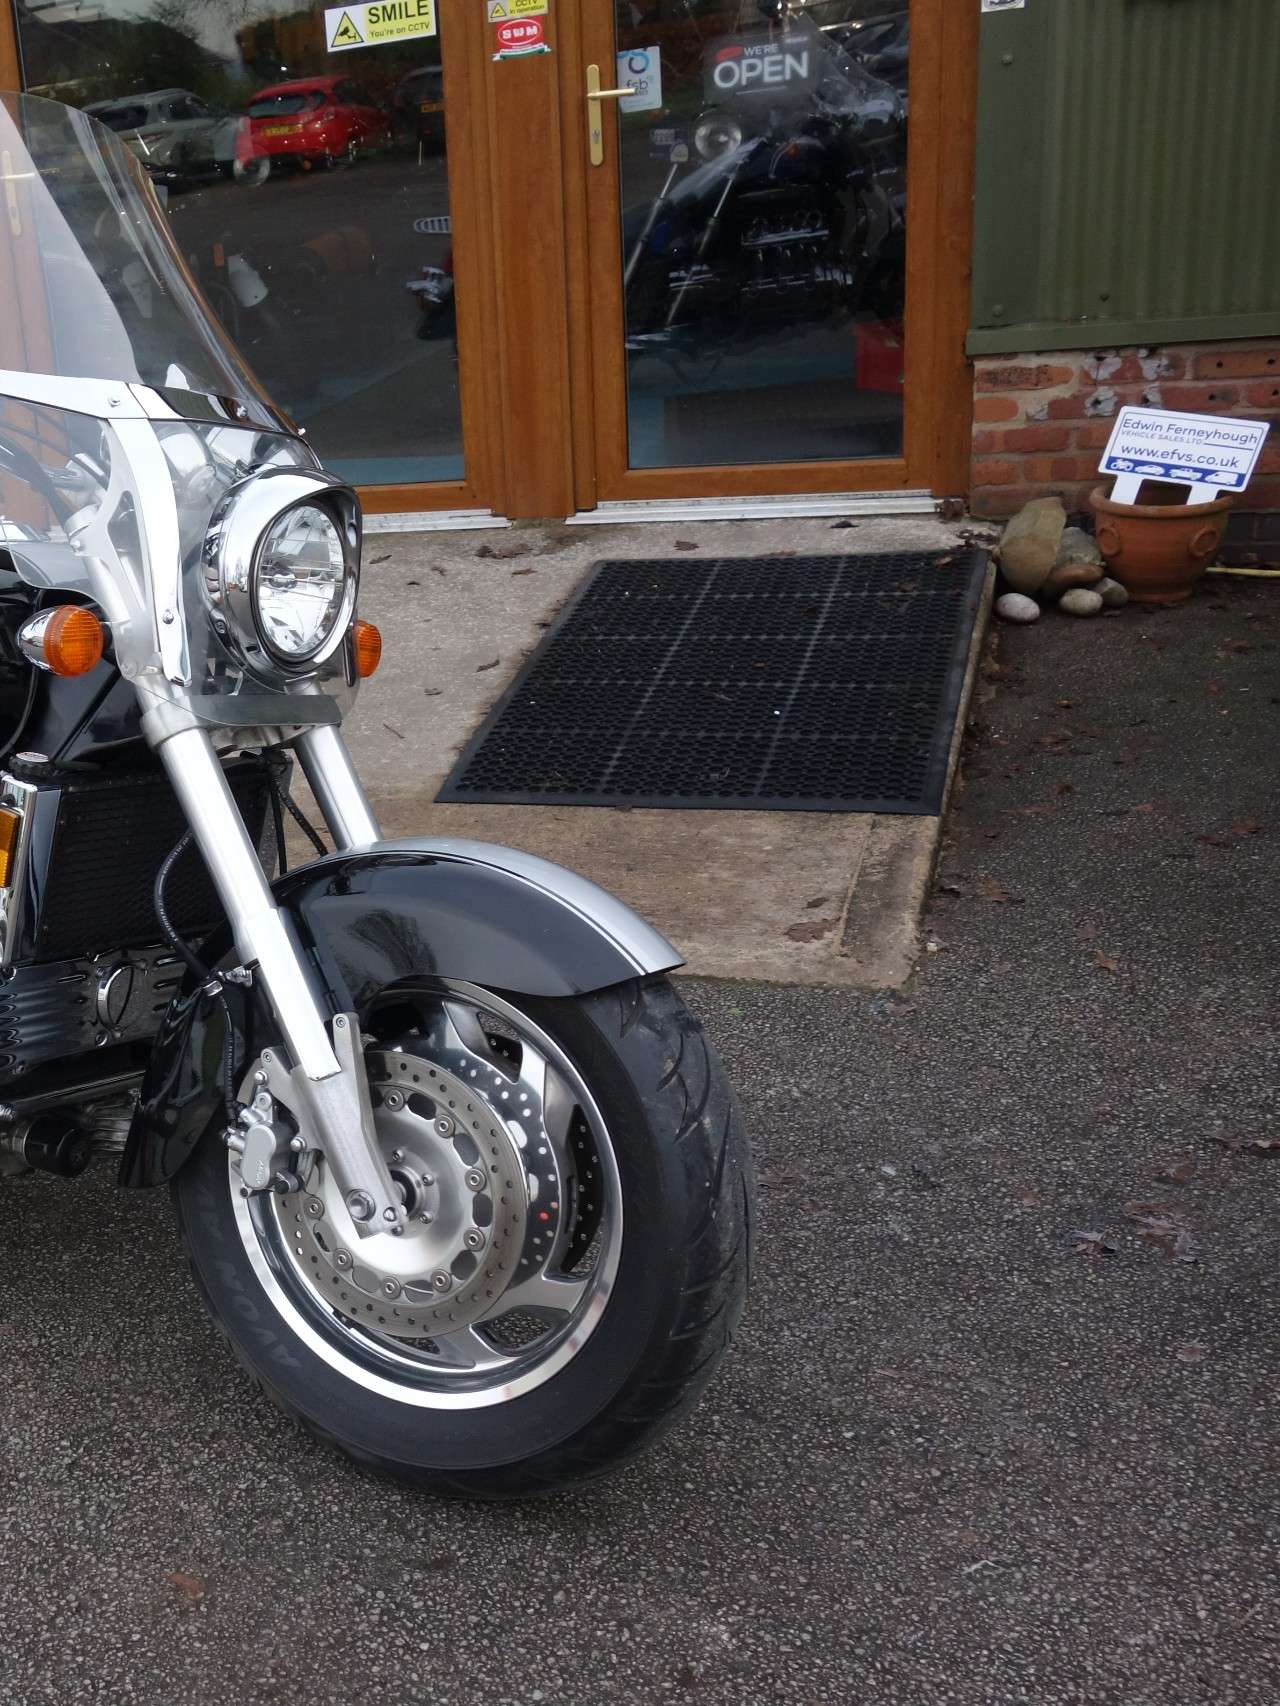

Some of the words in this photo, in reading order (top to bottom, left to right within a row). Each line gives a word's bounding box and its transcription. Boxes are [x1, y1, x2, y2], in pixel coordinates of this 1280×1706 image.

[368, 1, 429, 24] SMILE
[370, 28, 395, 39] You're
[396, 26, 406, 35] on
[408, 21, 431, 33] CCTV
[744, 43, 778, 56] WE'RE
[714, 51, 808, 88] OPEN
[1121, 430, 1156, 439] VEHICLE
[1158, 434, 1185, 443] SALES
[1122, 418, 1163, 432] Edwin
[1166, 423, 1258, 445] Ferneyhough
[1121, 444, 1240, 468] www.efvs.co.uk
[215, 1260, 304, 1368] AVON
